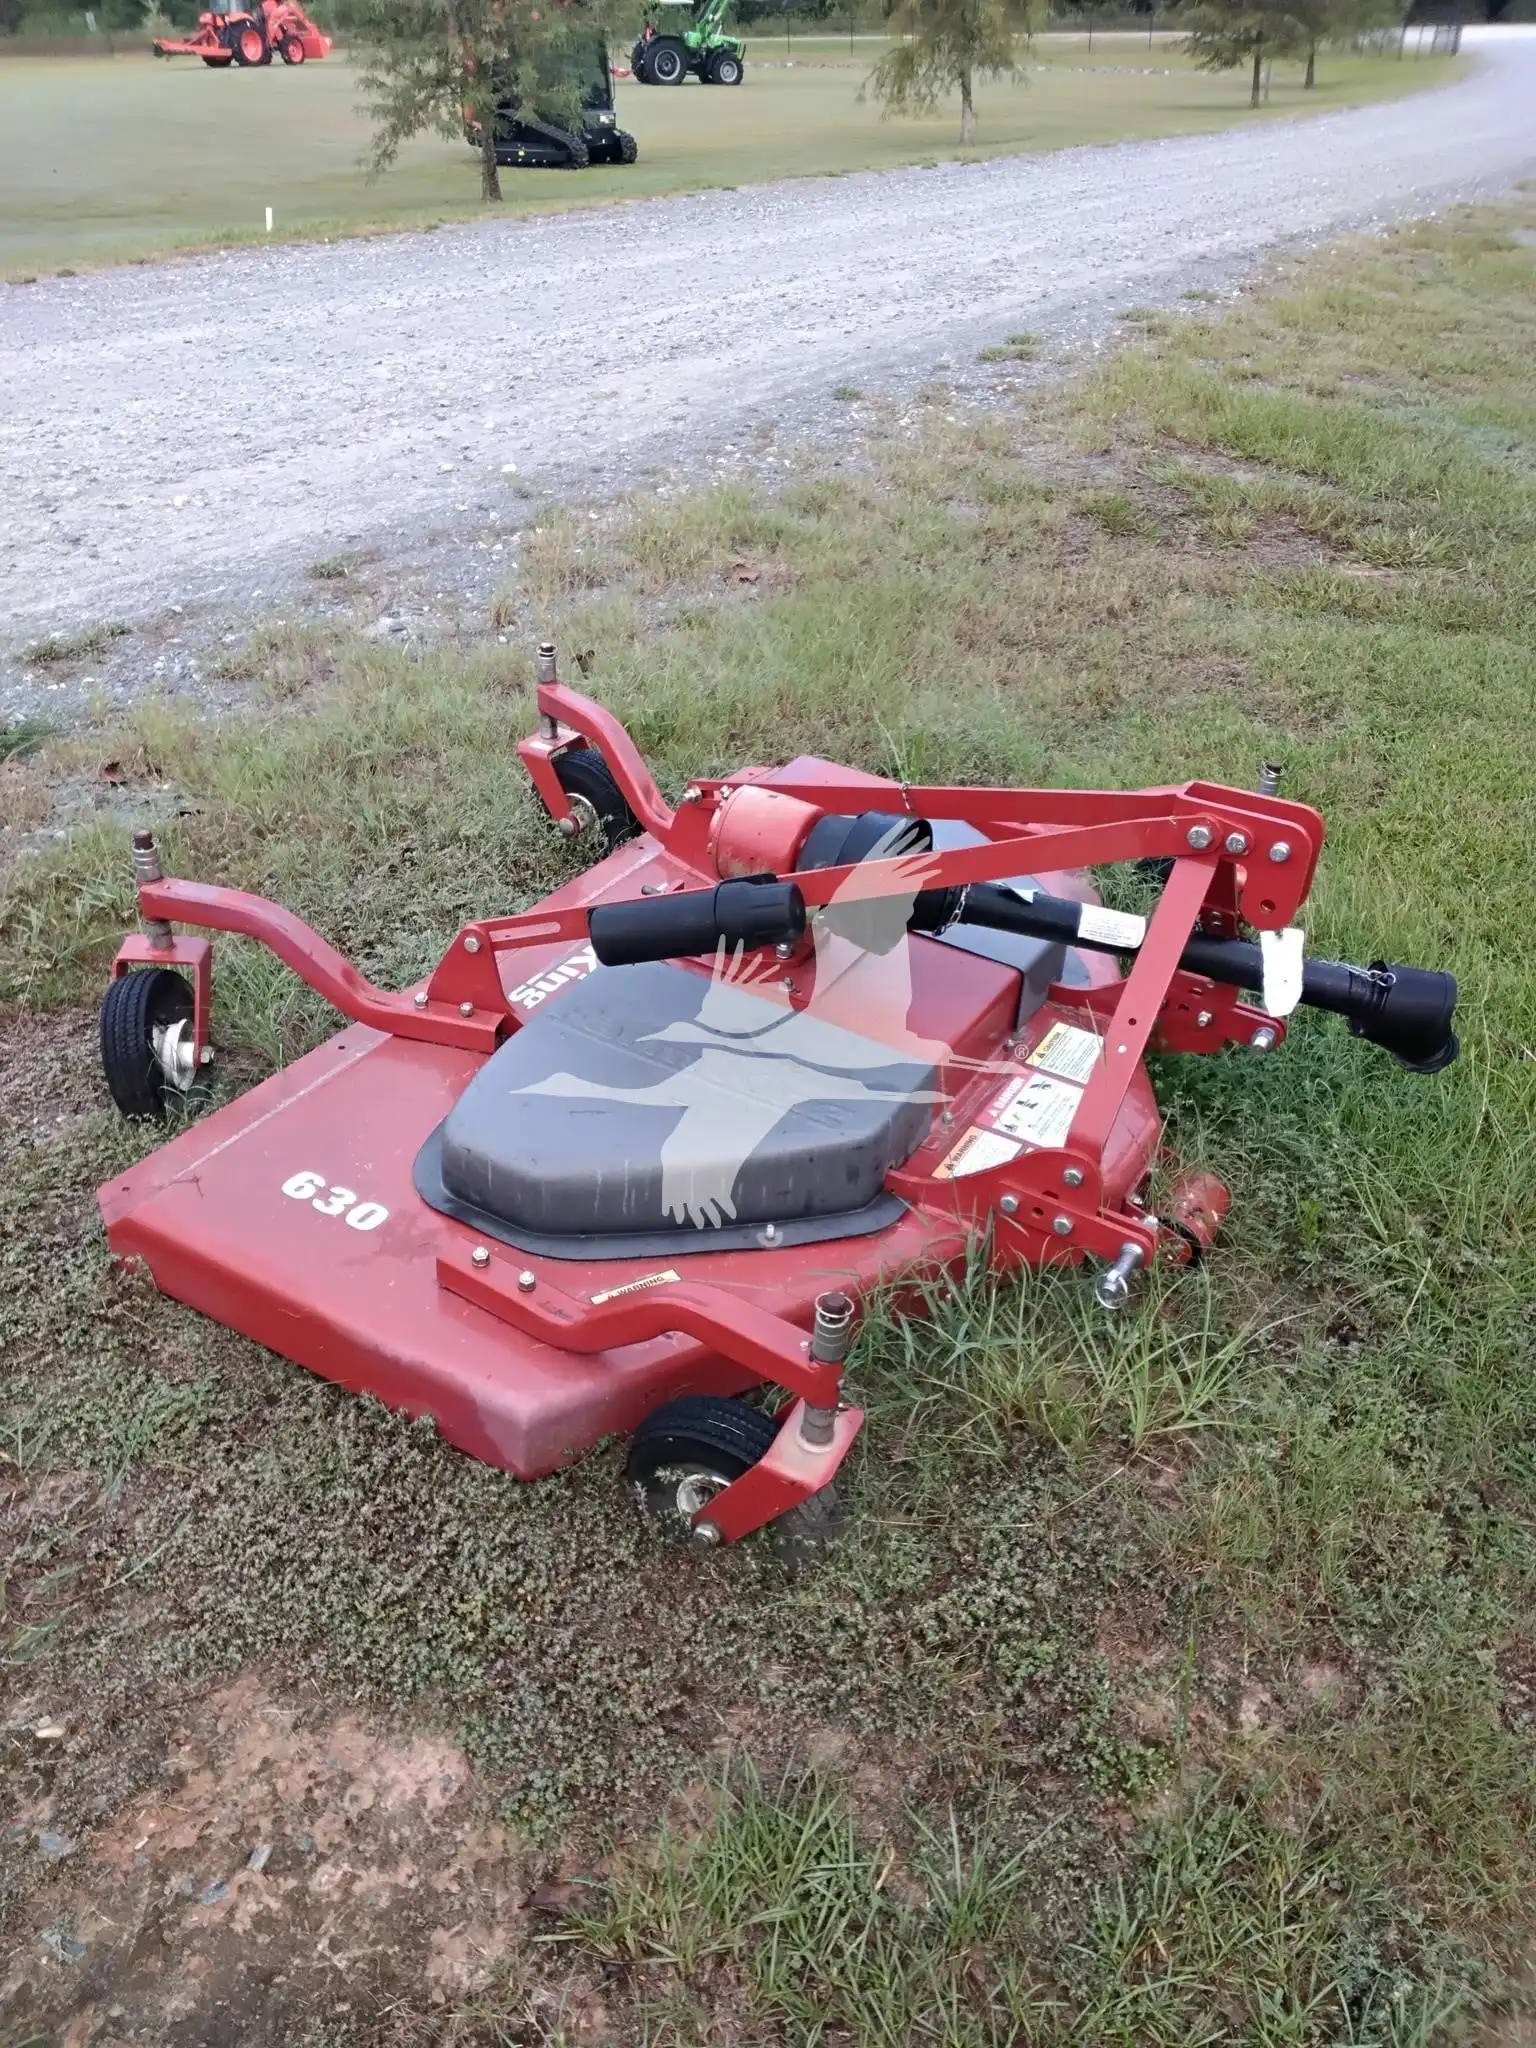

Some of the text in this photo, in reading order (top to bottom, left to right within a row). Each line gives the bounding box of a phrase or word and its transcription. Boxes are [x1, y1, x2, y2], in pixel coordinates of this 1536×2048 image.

[508, 944, 597, 1009] King
[955, 1134, 977, 1161] WARNING
[281, 1171, 389, 1230] 630
